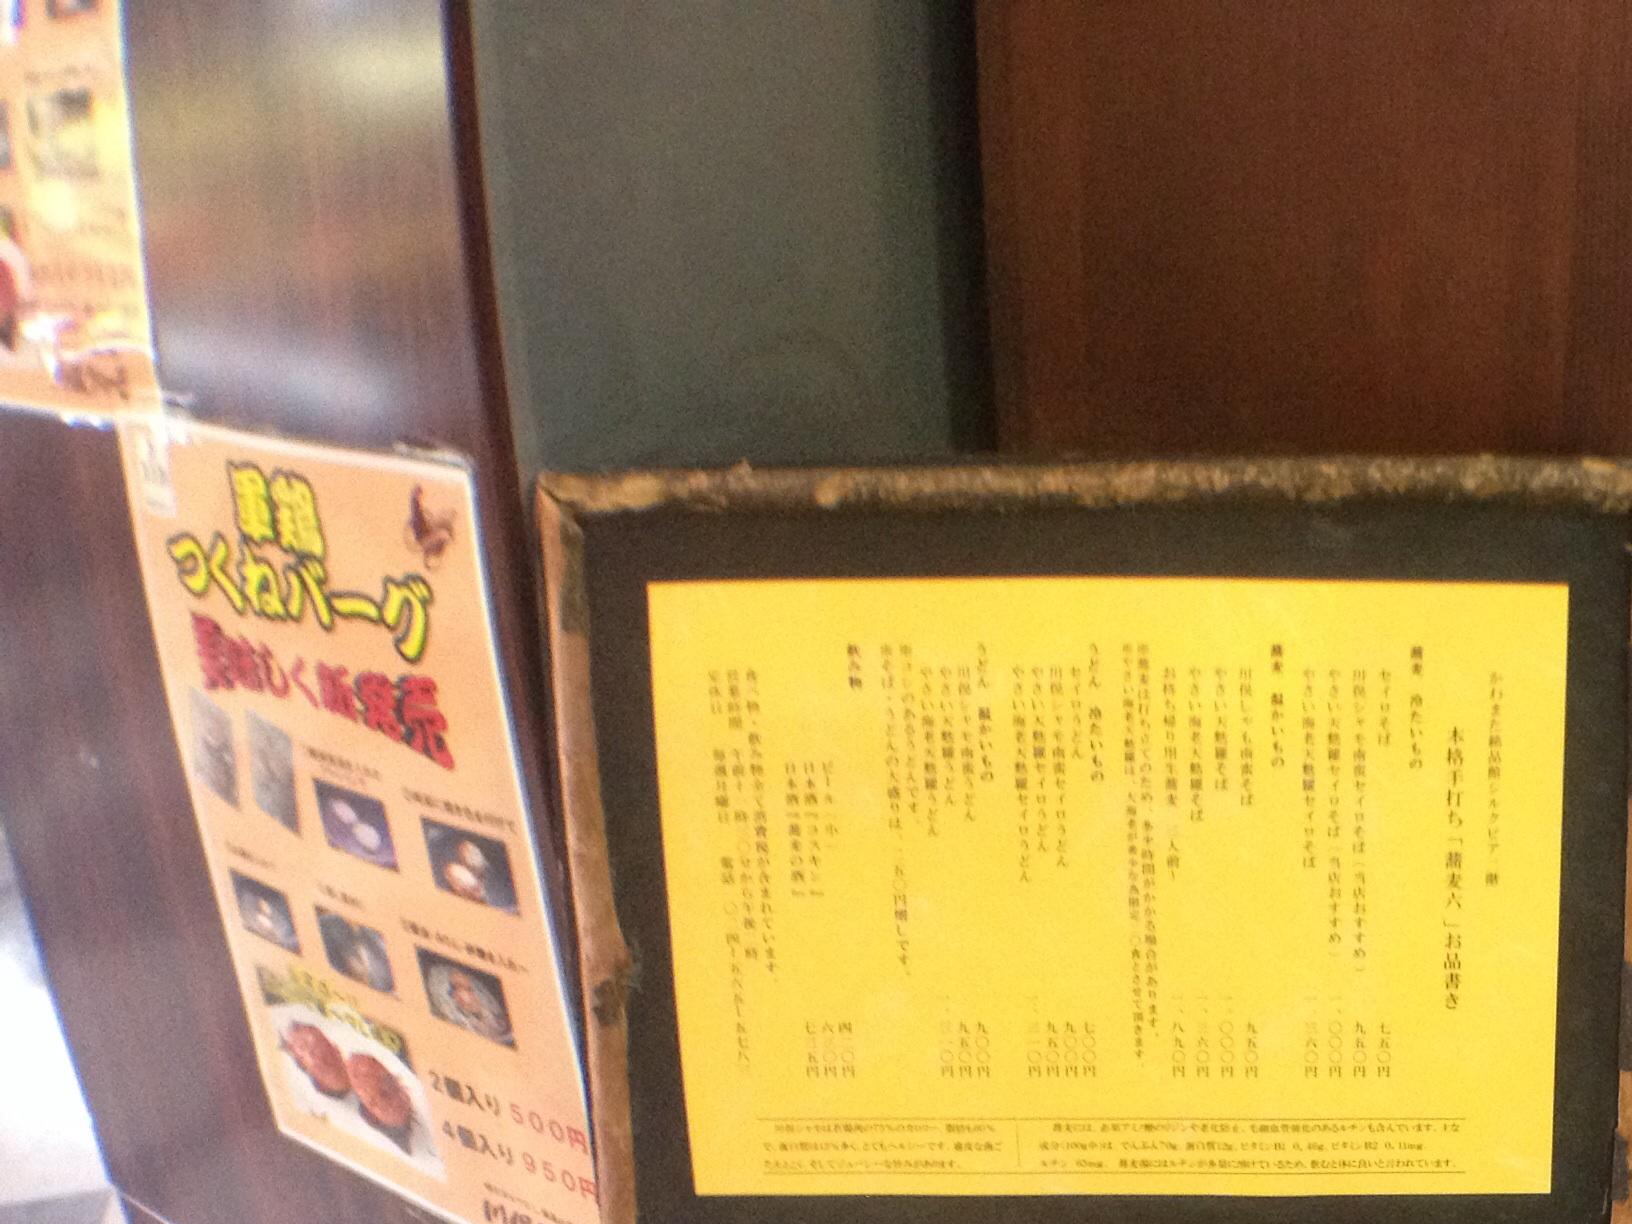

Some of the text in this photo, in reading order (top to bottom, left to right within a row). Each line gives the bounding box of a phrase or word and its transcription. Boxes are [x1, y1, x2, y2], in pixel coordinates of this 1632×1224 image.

[167, 530, 433, 664] つくねバーグ
